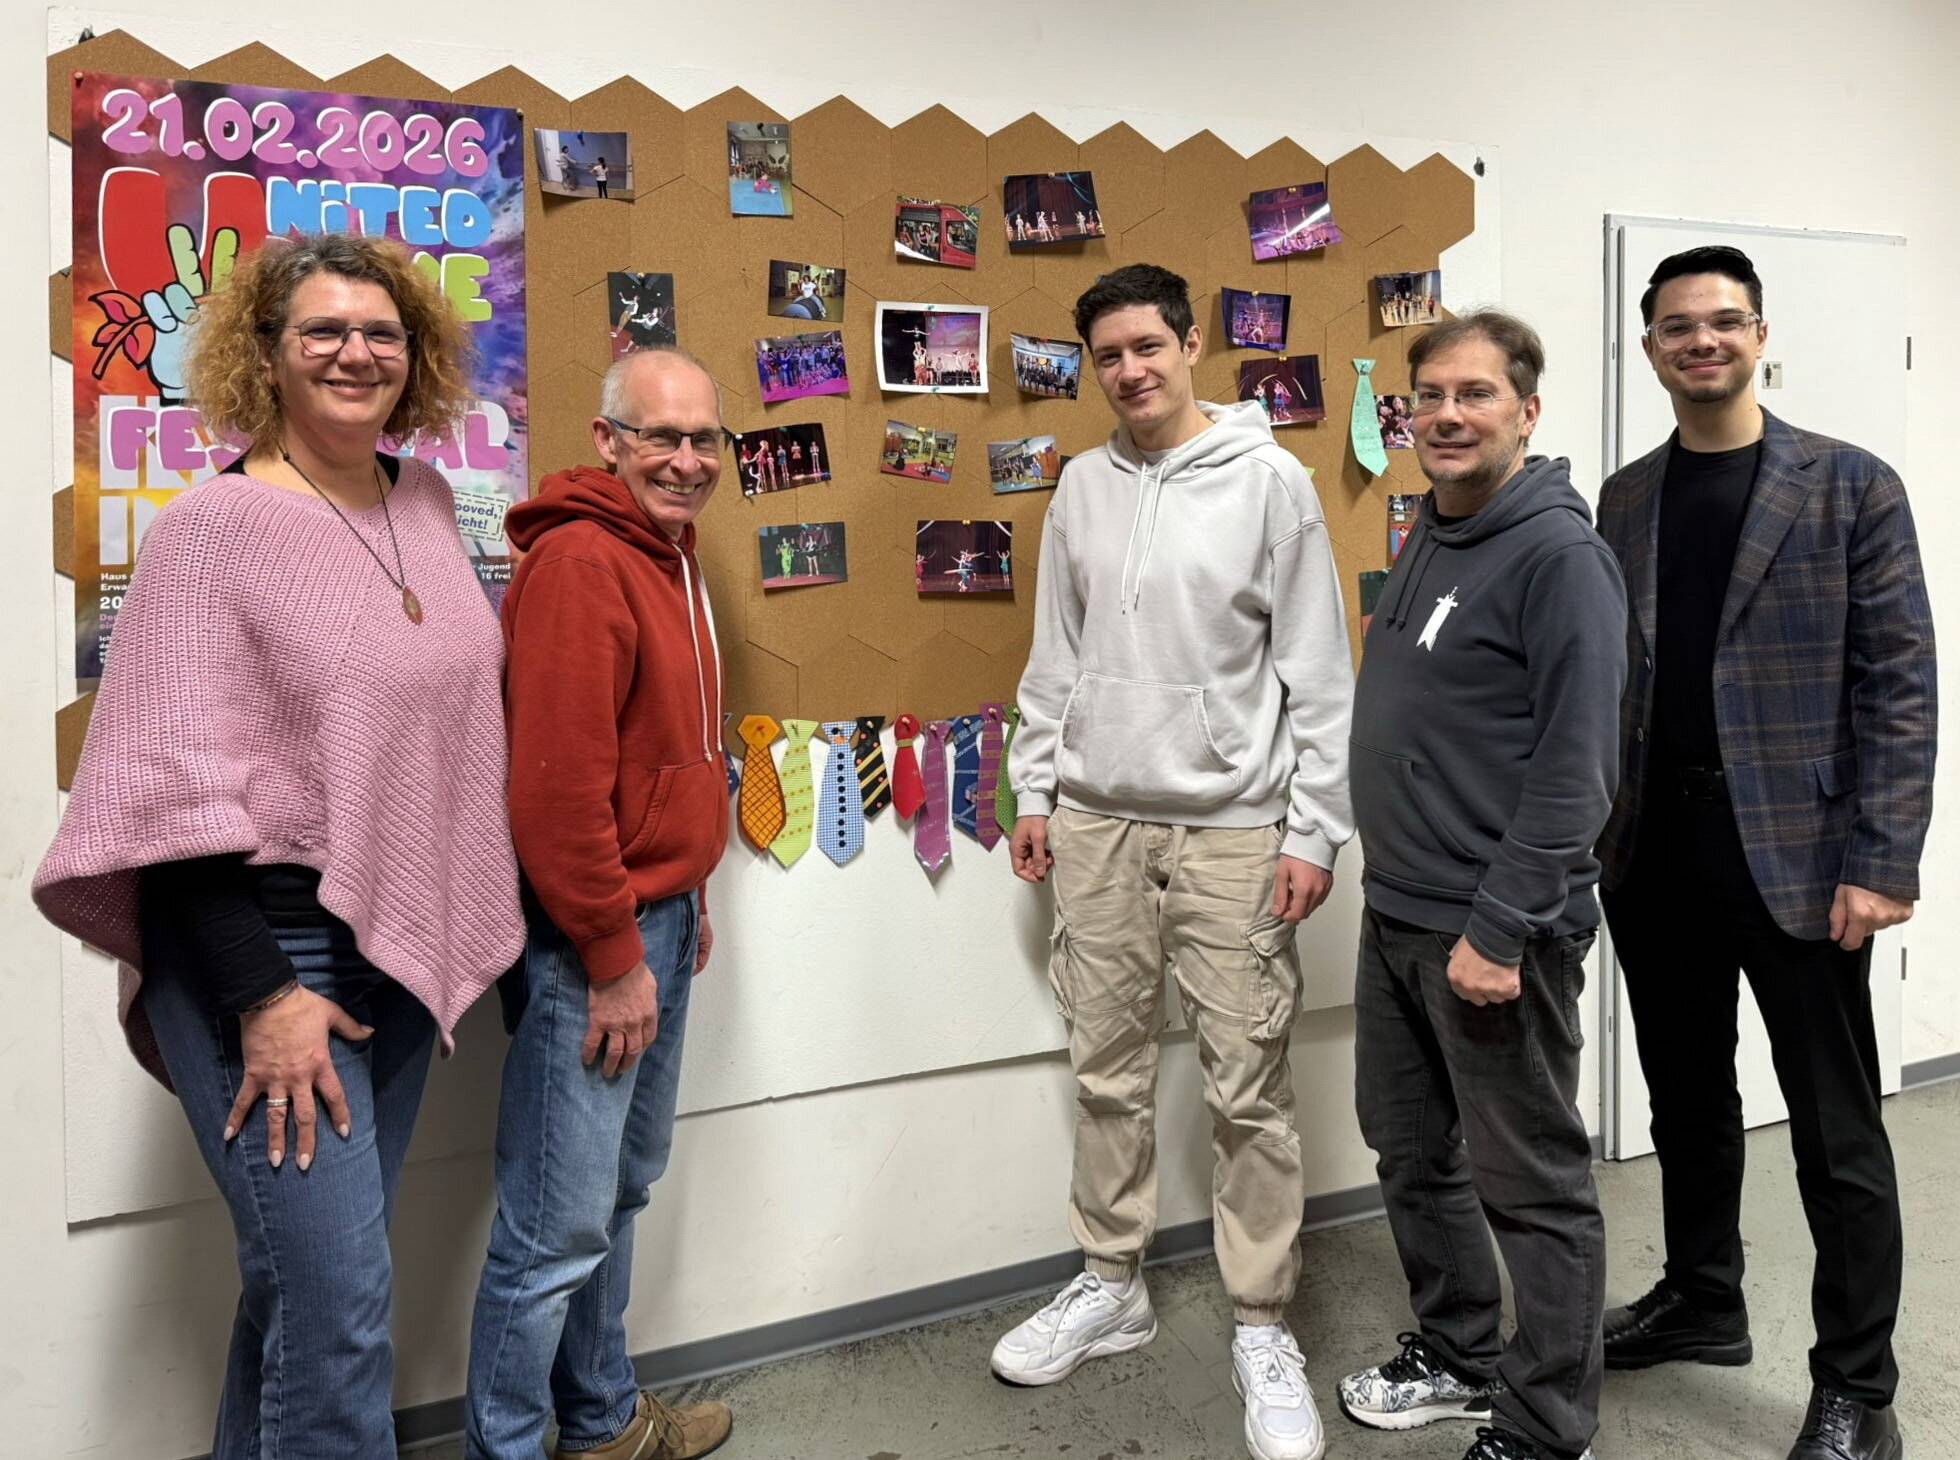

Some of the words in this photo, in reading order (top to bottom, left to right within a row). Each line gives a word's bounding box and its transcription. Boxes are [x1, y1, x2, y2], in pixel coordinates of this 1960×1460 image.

[101, 88, 490, 177] 21.02.2026
[453, 502, 498, 519] ooved,
[456, 514, 489, 530] icht!
[478, 563, 511, 572] Jugend
[100, 572, 128, 580] Haus
[481, 572, 492, 580] 16
[494, 572, 511, 580] frei
